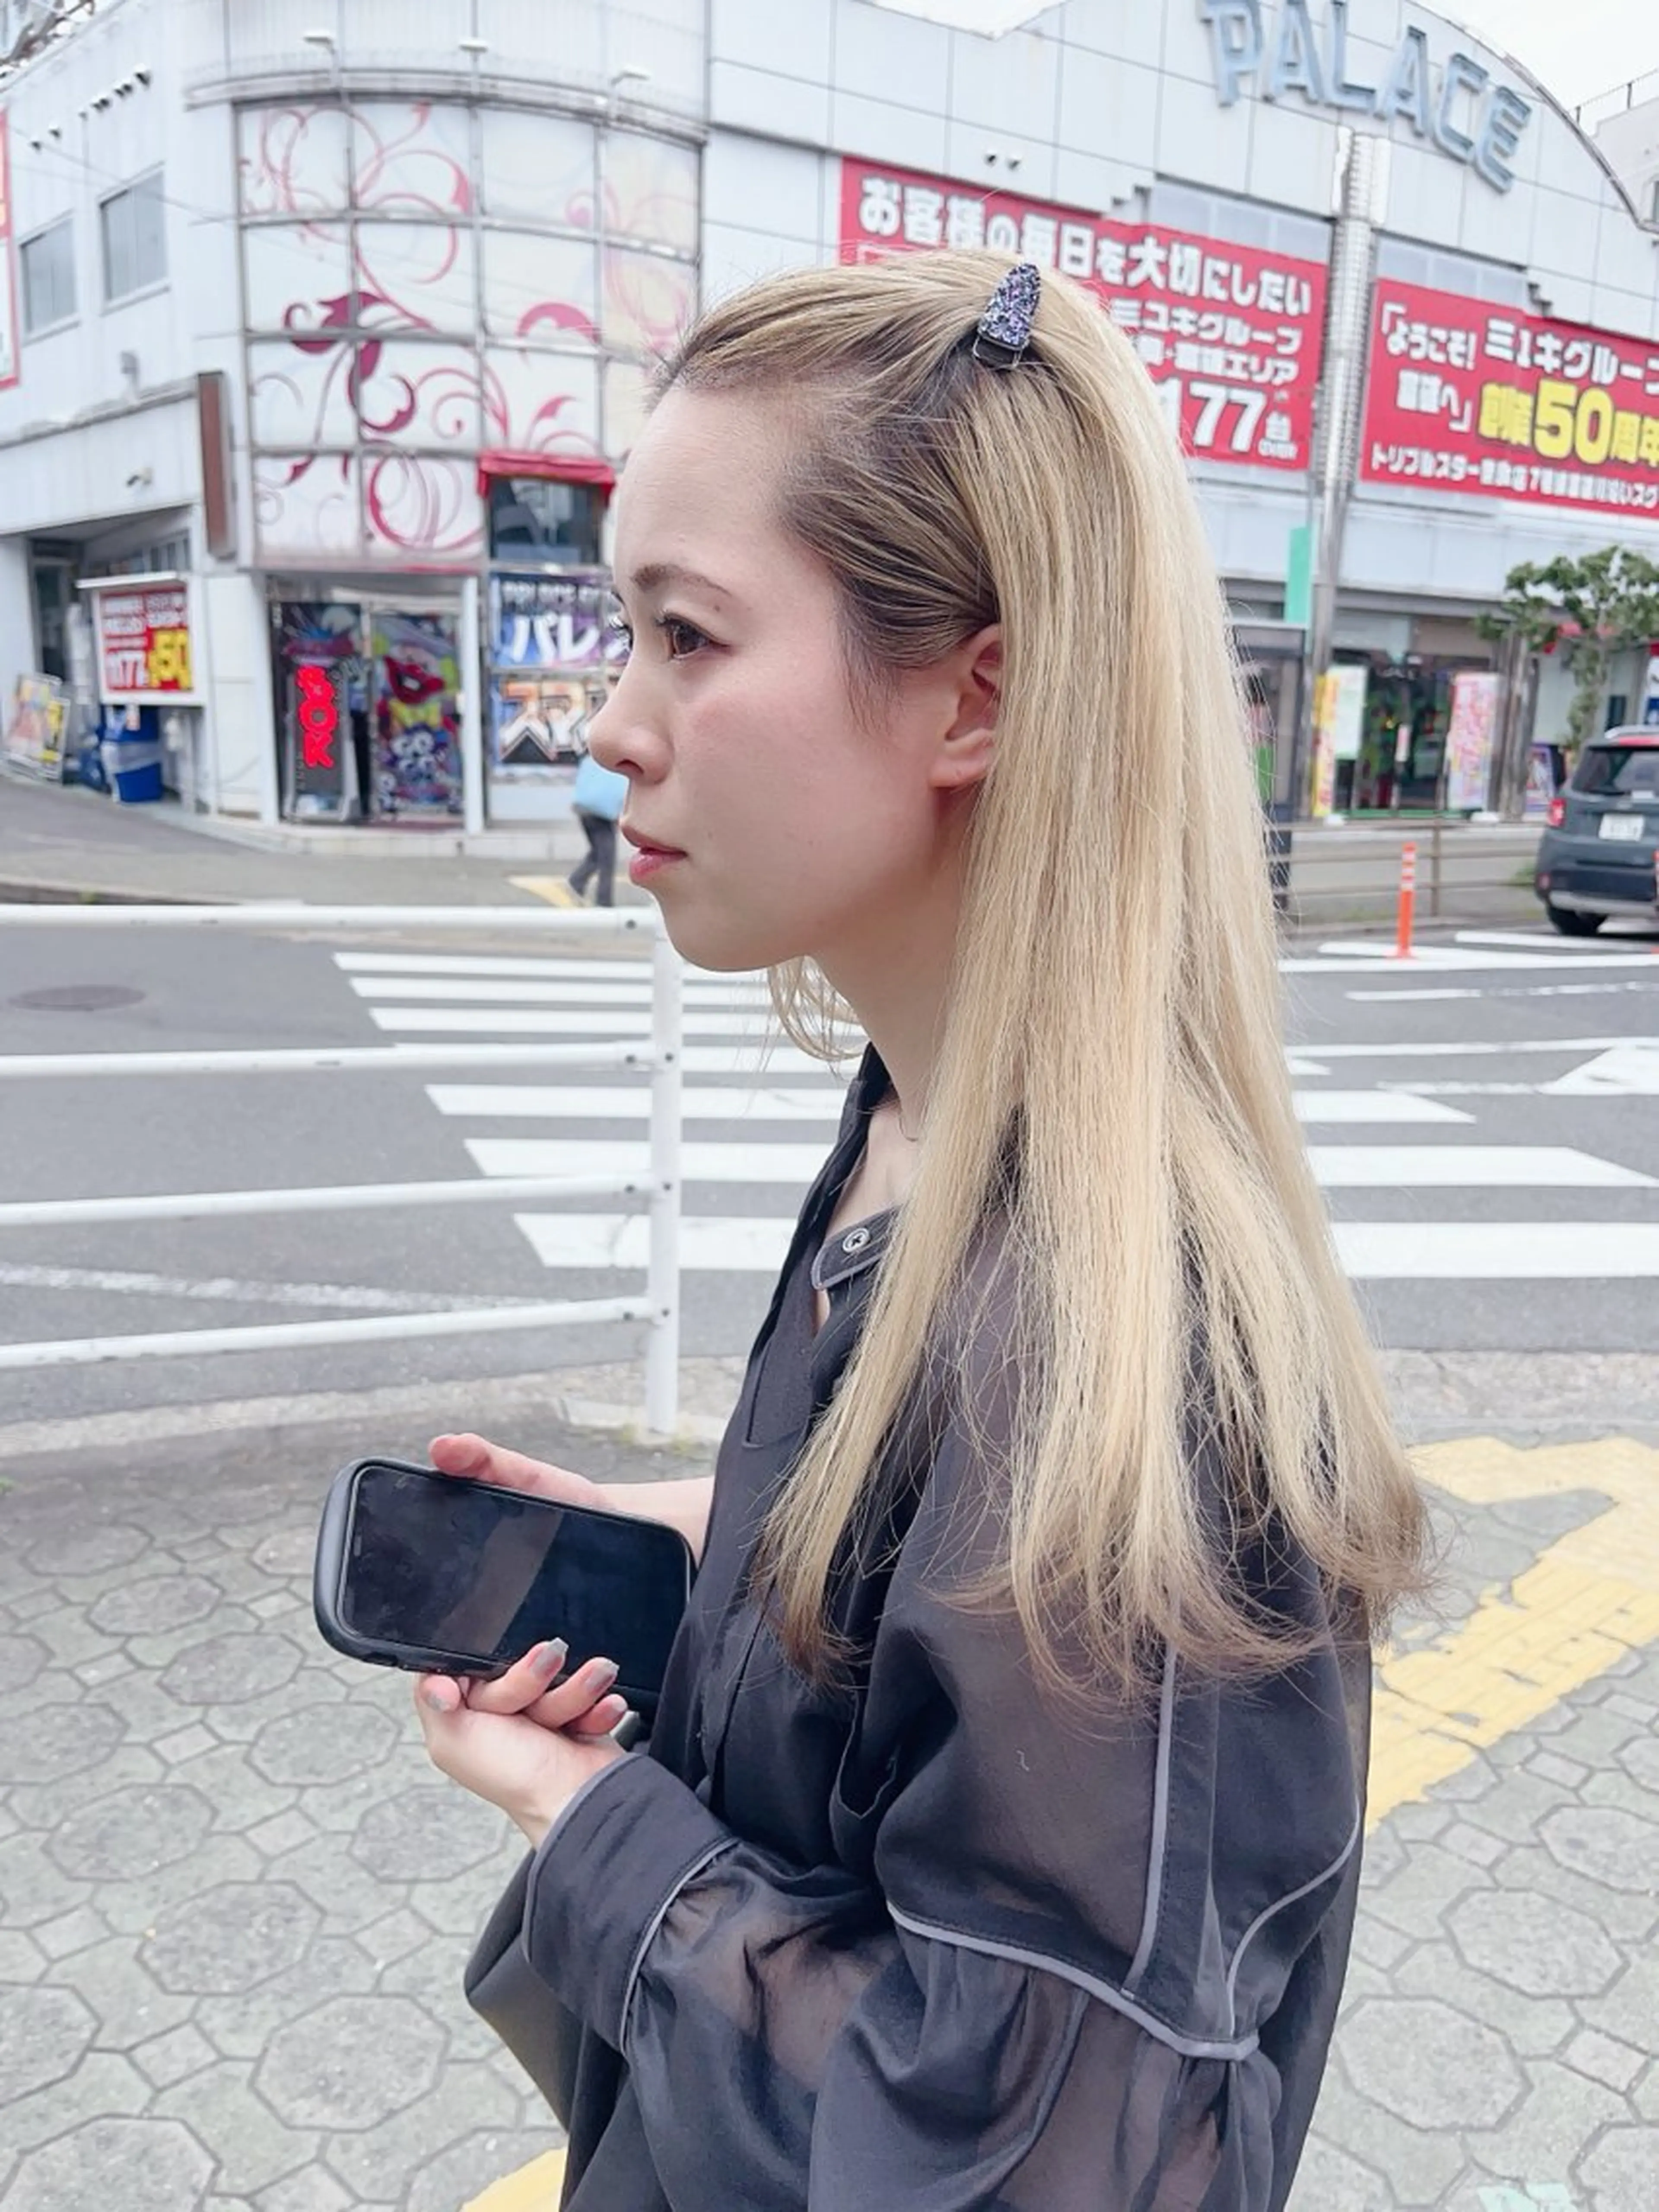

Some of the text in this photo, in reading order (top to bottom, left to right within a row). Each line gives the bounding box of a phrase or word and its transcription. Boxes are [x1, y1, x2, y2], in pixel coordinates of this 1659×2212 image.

[1201, 0, 1532, 194] PALACE
[859, 176, 1312, 317] お客様の毎日を大切にしたい
